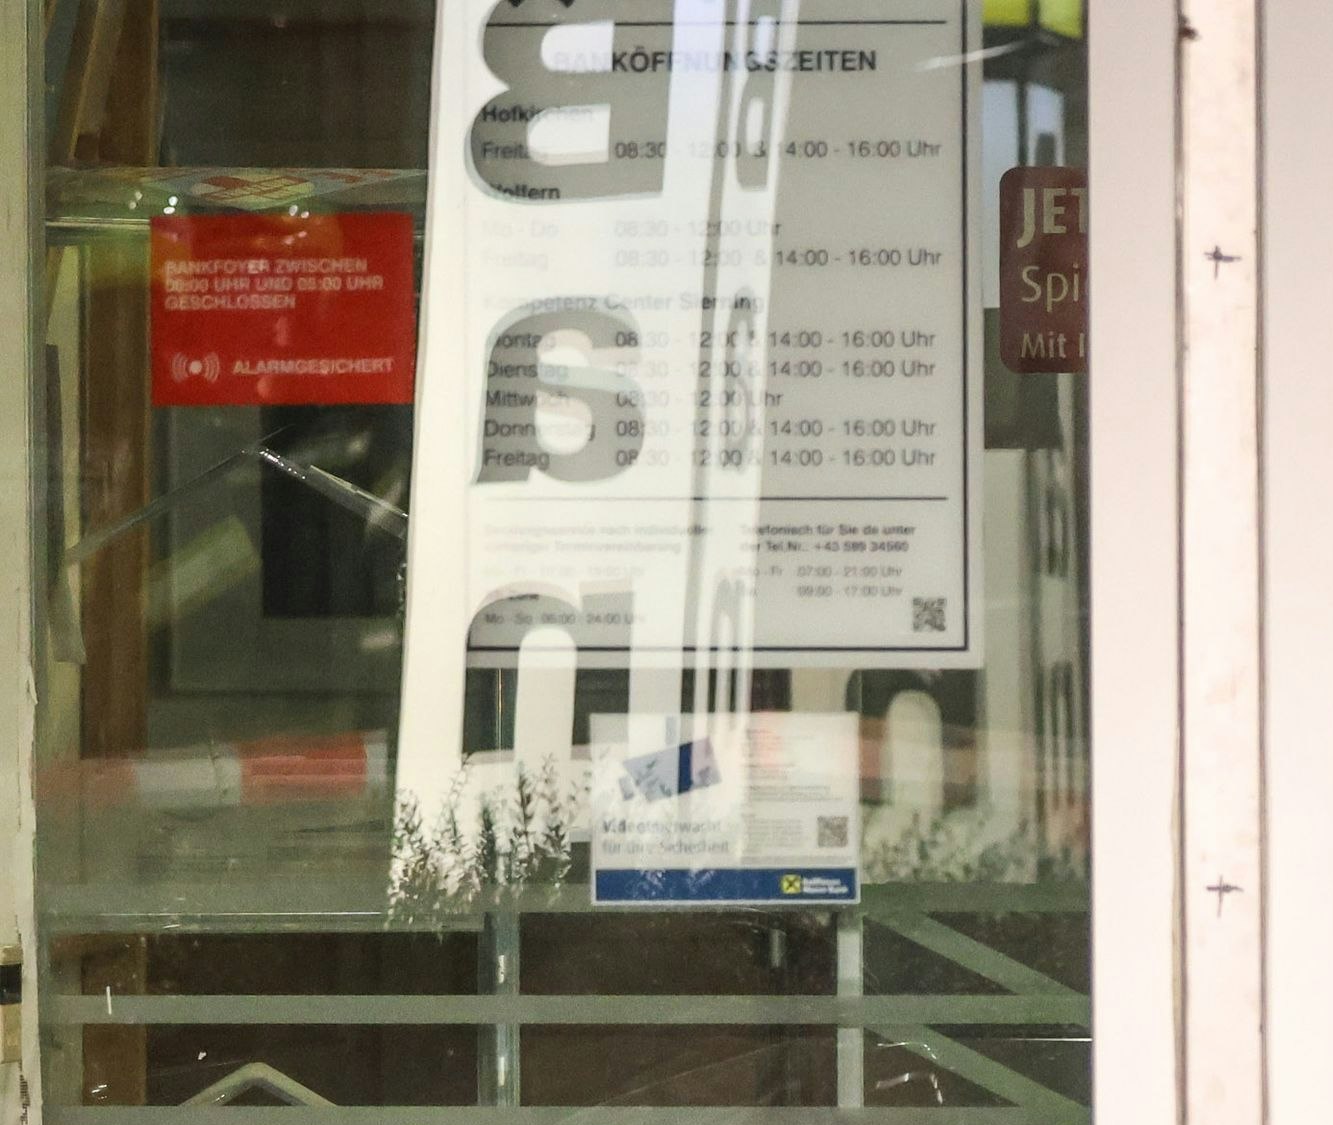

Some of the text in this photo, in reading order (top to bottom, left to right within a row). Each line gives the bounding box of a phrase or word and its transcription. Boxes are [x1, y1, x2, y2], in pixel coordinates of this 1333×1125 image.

[482, 142, 546, 163] Freita
[615, 142, 668, 159] 08:30
[848, 141, 901, 158] 16:00
[907, 141, 942, 158] Uhr
[486, 184, 561, 200] olfern
[776, 249, 829, 266] 14:00
[849, 249, 901, 266] 16:00
[908, 249, 942, 266] Uhr
[166, 258, 367, 275] BANKFOYER ZWISCHEN
[214, 278, 250, 292] UHR
[255, 277, 292, 291] UND
[346, 275, 383, 290] UHR
[165, 294, 296, 310] GESCHLOSSEN
[485, 331, 557, 353] ontag
[770, 331, 822, 348] 14:00
[842, 331, 895, 348] 16:00
[902, 331, 936, 347] Uhr
[1021, 331, 1067, 359] Mit
[233, 356, 394, 375] ALARMGESICHERT
[770, 360, 822, 377] 14:00
[842, 360, 895, 377] 16:00
[902, 360, 936, 377] Uhr
[771, 420, 823, 437] 14:00
[843, 420, 896, 437] 16:00
[902, 420, 936, 437] Uhr
[484, 450, 551, 471] Freitag
[771, 449, 823, 467] 14:00
[844, 449, 896, 467] 16:00
[903, 449, 936, 466] Uhr
[839, 523, 858, 536] Sie
